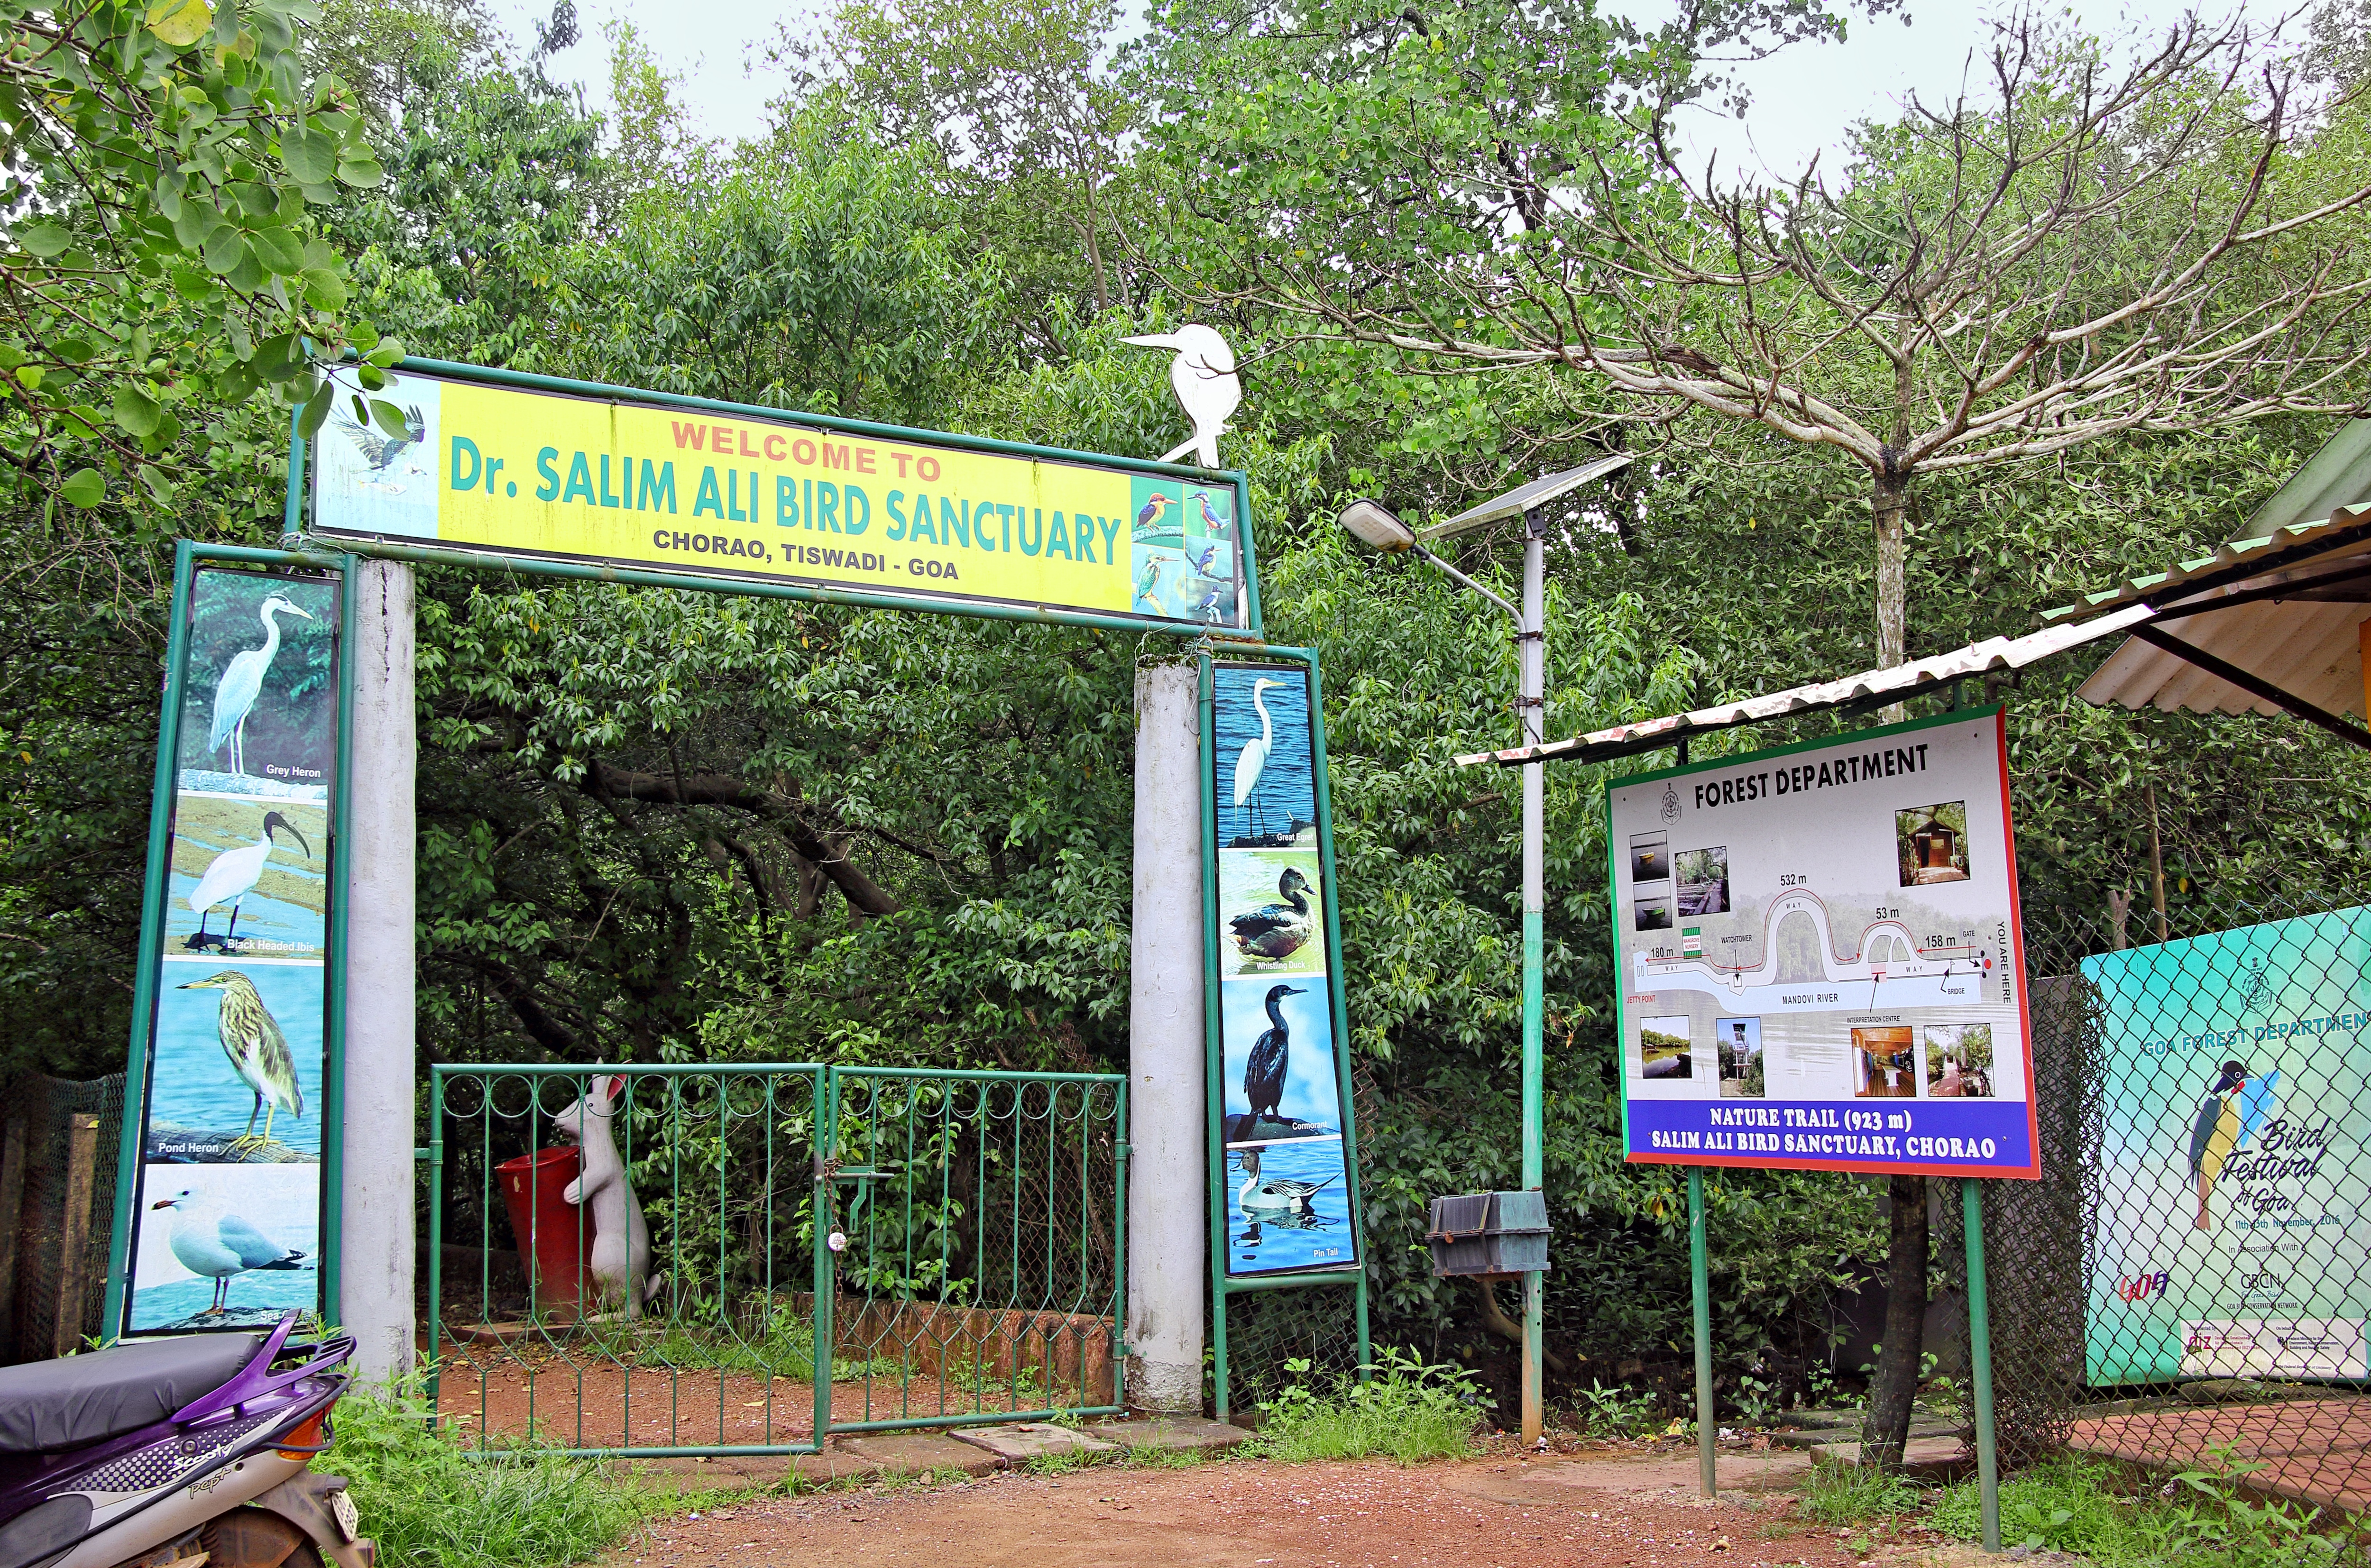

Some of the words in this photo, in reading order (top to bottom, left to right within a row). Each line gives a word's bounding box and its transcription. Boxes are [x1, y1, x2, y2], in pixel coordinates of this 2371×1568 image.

[671, 421, 876, 474] WELCOME
[891, 452, 941, 482] TO
[451, 436, 517, 498] Dr.
[536, 447, 677, 514] SALIM
[693, 466, 758, 523] ALI
[776, 475, 870, 535] BIRD
[886, 490, 1121, 565] SANCTUARY
[653, 530, 772, 563] CHORAO,
[781, 543, 884, 572] TISWADI
[909, 558, 959, 580] GOA
[266, 764, 290, 778] Grey
[291, 765, 321, 778] Heron
[1695, 773, 1768, 809] FOREST
[1775, 743, 1928, 795] DEPARTMENT
[1277, 833, 1295, 841] Great
[1296, 833, 1314, 843] Egret
[1780, 874, 1796, 886] 532
[1798, 875, 1807, 884] m
[1876, 907, 1888, 919] 53
[1890, 908, 1899, 918] m
[1721, 934, 1752, 944] WATCHTOWER
[1997, 921, 2006, 944] YOU
[227, 938, 255, 949] Black
[257, 939, 294, 951] Headed
[296, 941, 314, 952] Ibis
[1925, 935, 1943, 947] 158
[1946, 936, 1956, 946] m
[1651, 947, 1664, 958] 180
[1666, 948, 1673, 957] m
[1999, 947, 2009, 971] ARE
[1256, 961, 1287, 971] Whistling
[1288, 961, 1305, 969] Duck
[2001, 973, 2011, 1004] HERE
[1640, 995, 1655, 1003] POINT
[1782, 994, 1814, 1004] MANDOVI
[1817, 993, 1838, 1003] RIVER
[2143, 1041, 2178, 1056] GOA
[2182, 1027, 2248, 1052] FOREST
[2254, 1011, 2371, 1042] DEPARTMEN
[1292, 1120, 1327, 1130] Cormorant
[1709, 1107, 1780, 1128] NATURE
[1783, 1108, 1839, 1128] TRAIL
[1844, 1109, 1883, 1132] (923
[1887, 1109, 1912, 1133] m)
[2260, 1117, 2331, 1151] Bird
[158, 1142, 185, 1153] Pond
[188, 1142, 219, 1153] Heron
[1652, 1130, 1700, 1149] SALIM
[1704, 1131, 1733, 1150] ALI
[1737, 1132, 1780, 1152] BIRD
[1784, 1133, 1901, 1160] SANCTUARY,
[1906, 1136, 1996, 1158] CHORAO
[2221, 1146, 2327, 1183] Festival
[2252, 1188, 2290, 1216] Goa
[2320, 1214, 2340, 1225] 2016
[1313, 1249, 1324, 1258] Pin
[1325, 1247, 1338, 1256] Tail
[2281, 1243, 2298, 1251] With
[2241, 1273, 2280, 1289] GBCN
[261, 1310, 279, 1320] Sea
[167, 1443, 234, 1473] Scooty
